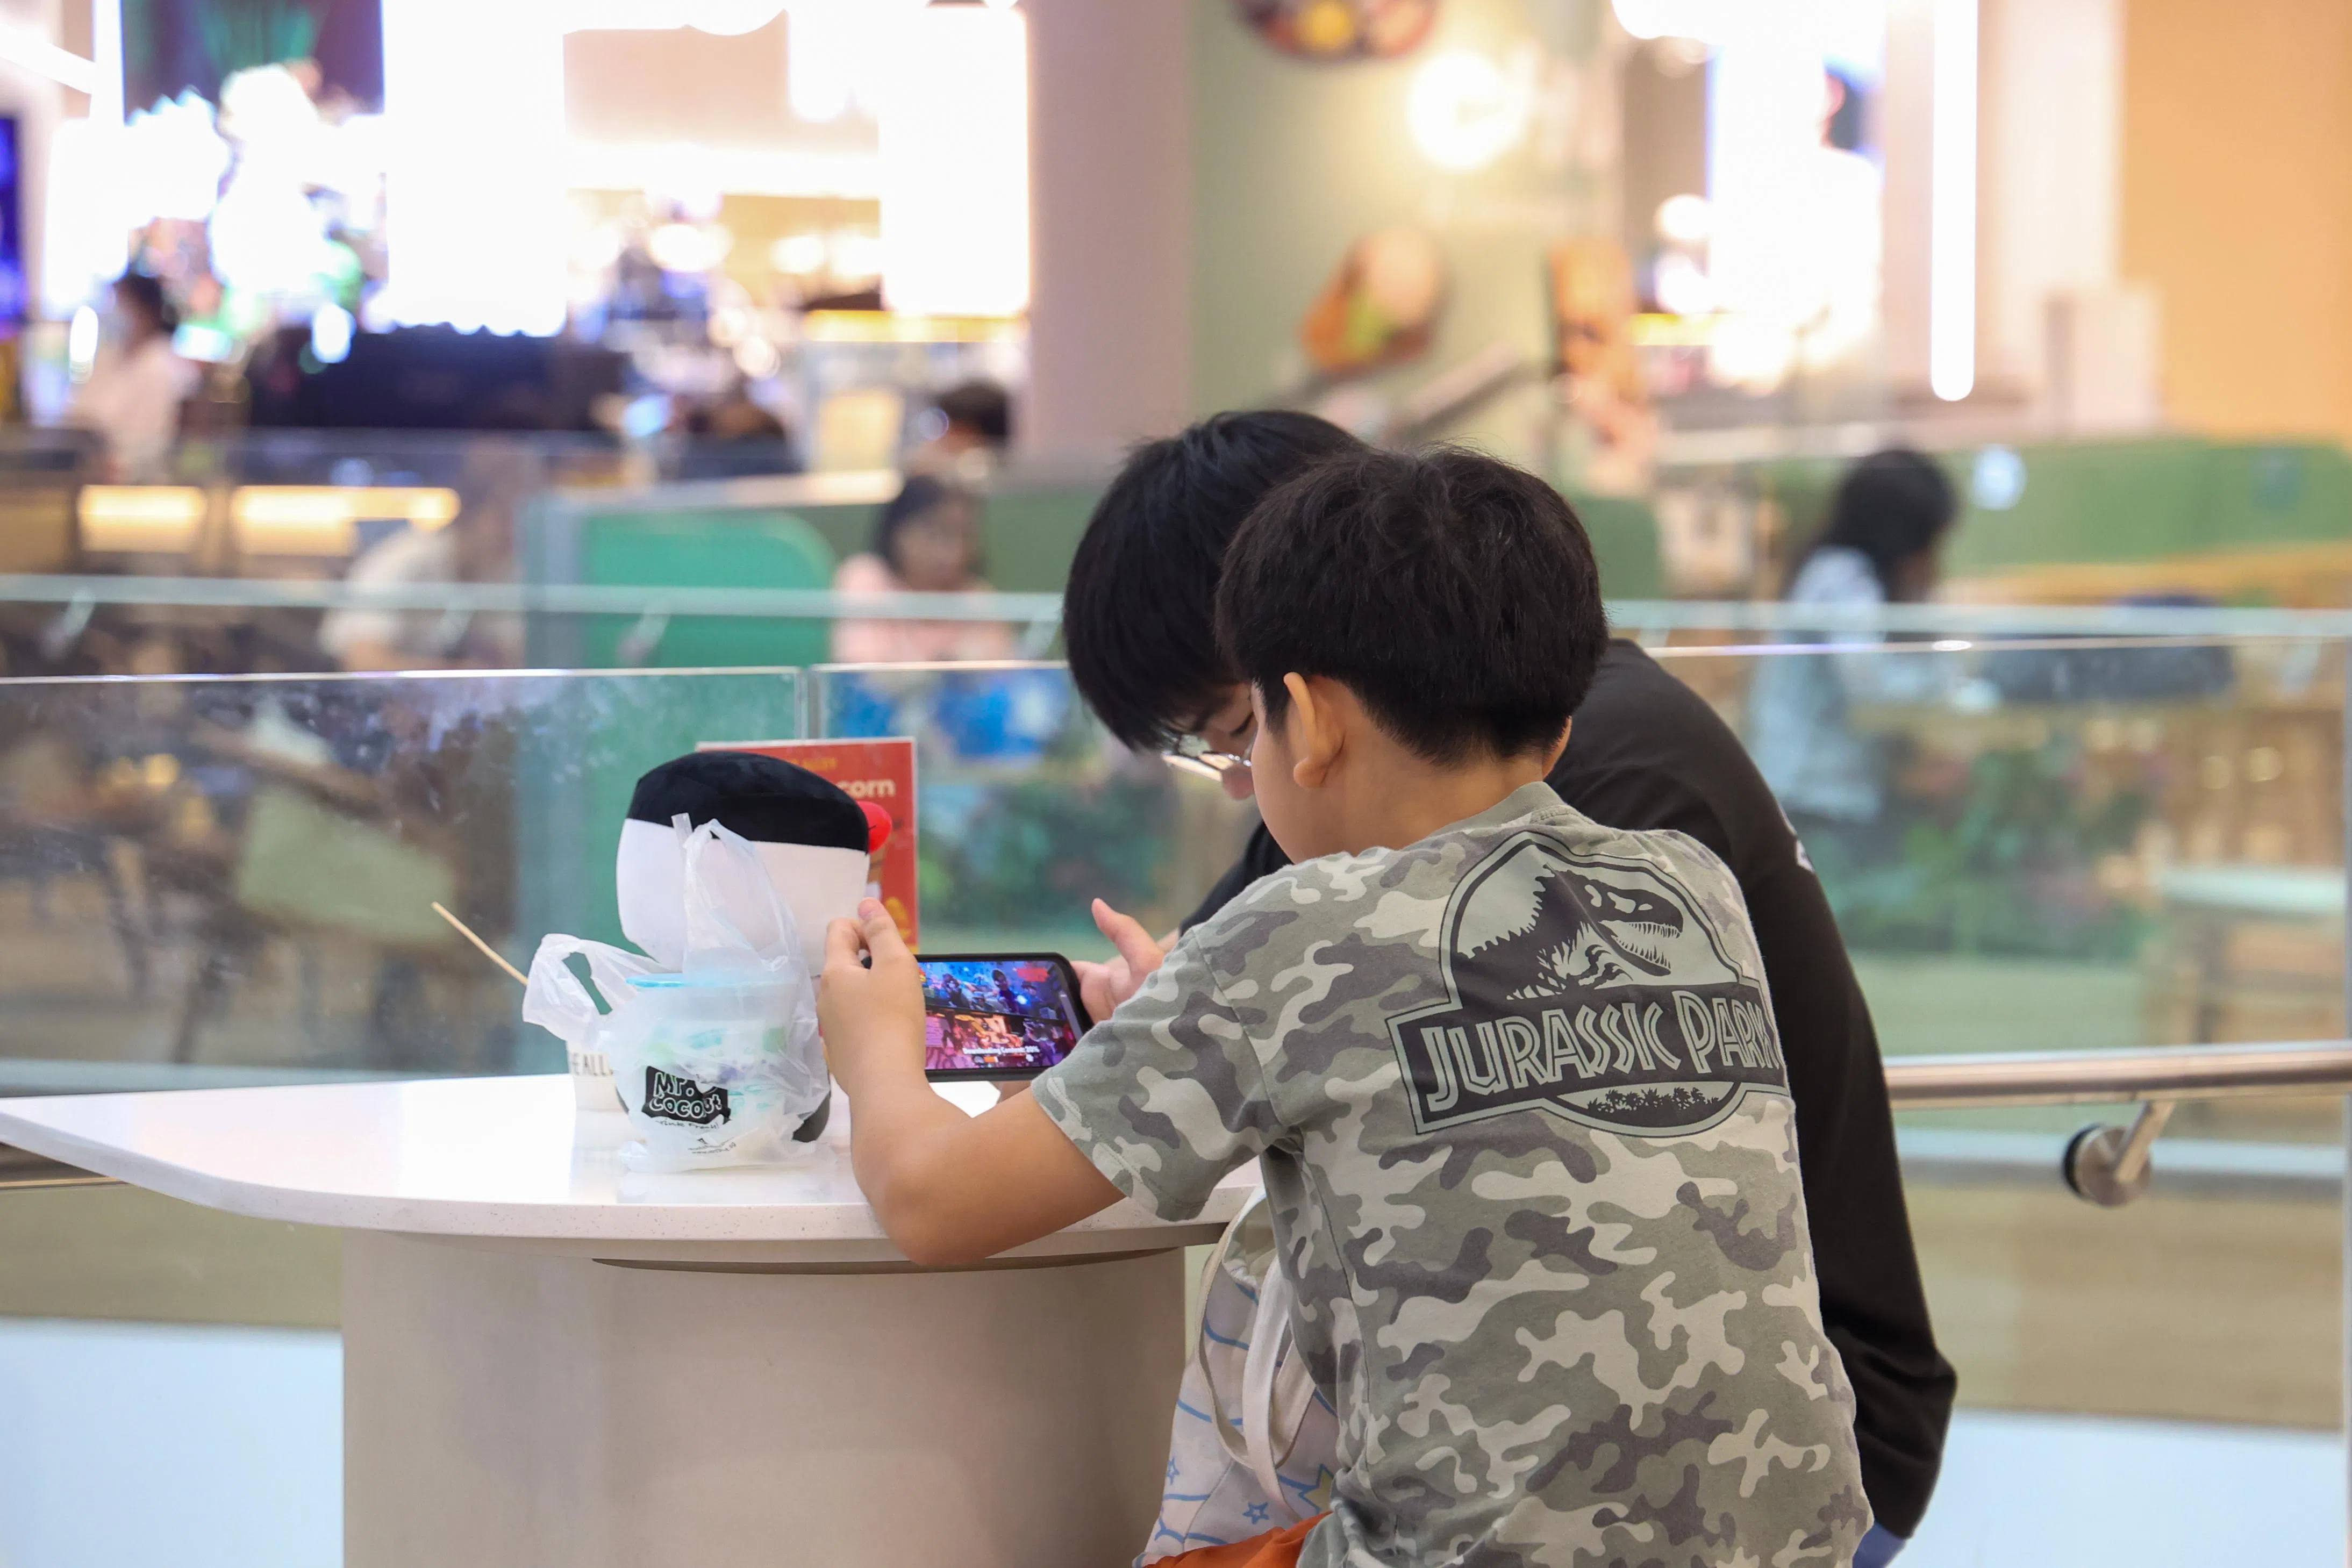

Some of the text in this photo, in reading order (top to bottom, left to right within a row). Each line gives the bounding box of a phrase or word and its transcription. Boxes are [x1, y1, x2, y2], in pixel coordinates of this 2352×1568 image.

[653, 1071, 695, 1099] Mr.
[1420, 990, 1779, 1112] JURASSIC PARK
